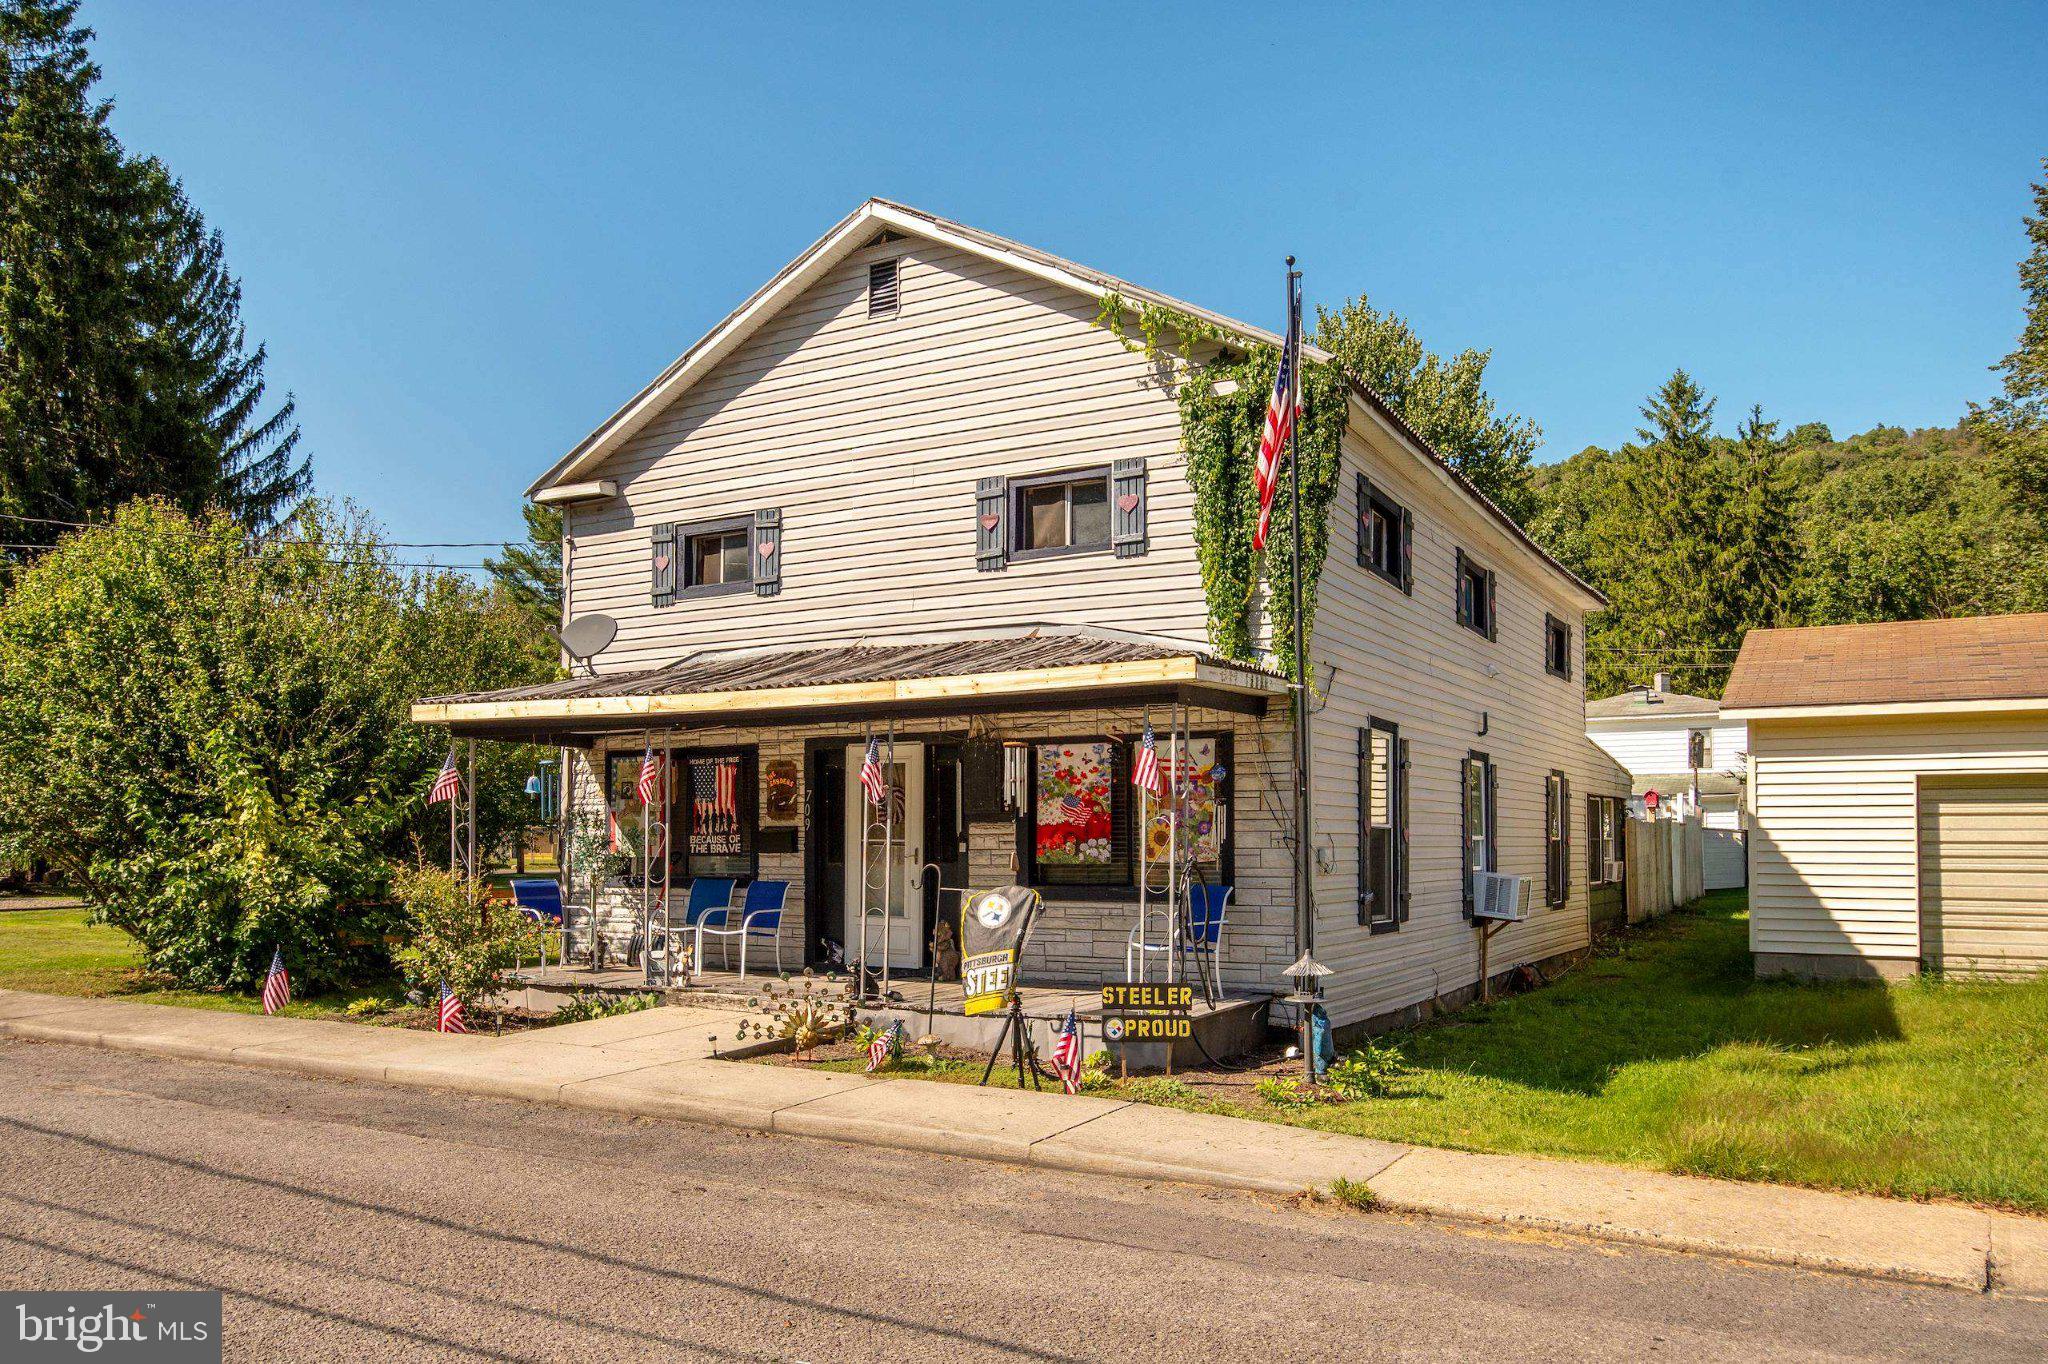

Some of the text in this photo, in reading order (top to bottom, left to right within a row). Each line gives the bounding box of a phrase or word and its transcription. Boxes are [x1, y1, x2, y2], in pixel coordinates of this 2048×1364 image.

[689, 834, 741, 844] BECAUSE OF
[690, 843, 741, 854] THE BRAVE
[963, 953, 1009, 970] PITTSBURGH
[1102, 986, 1193, 1006] STEELER
[1124, 1019, 1191, 1038] PROUD
